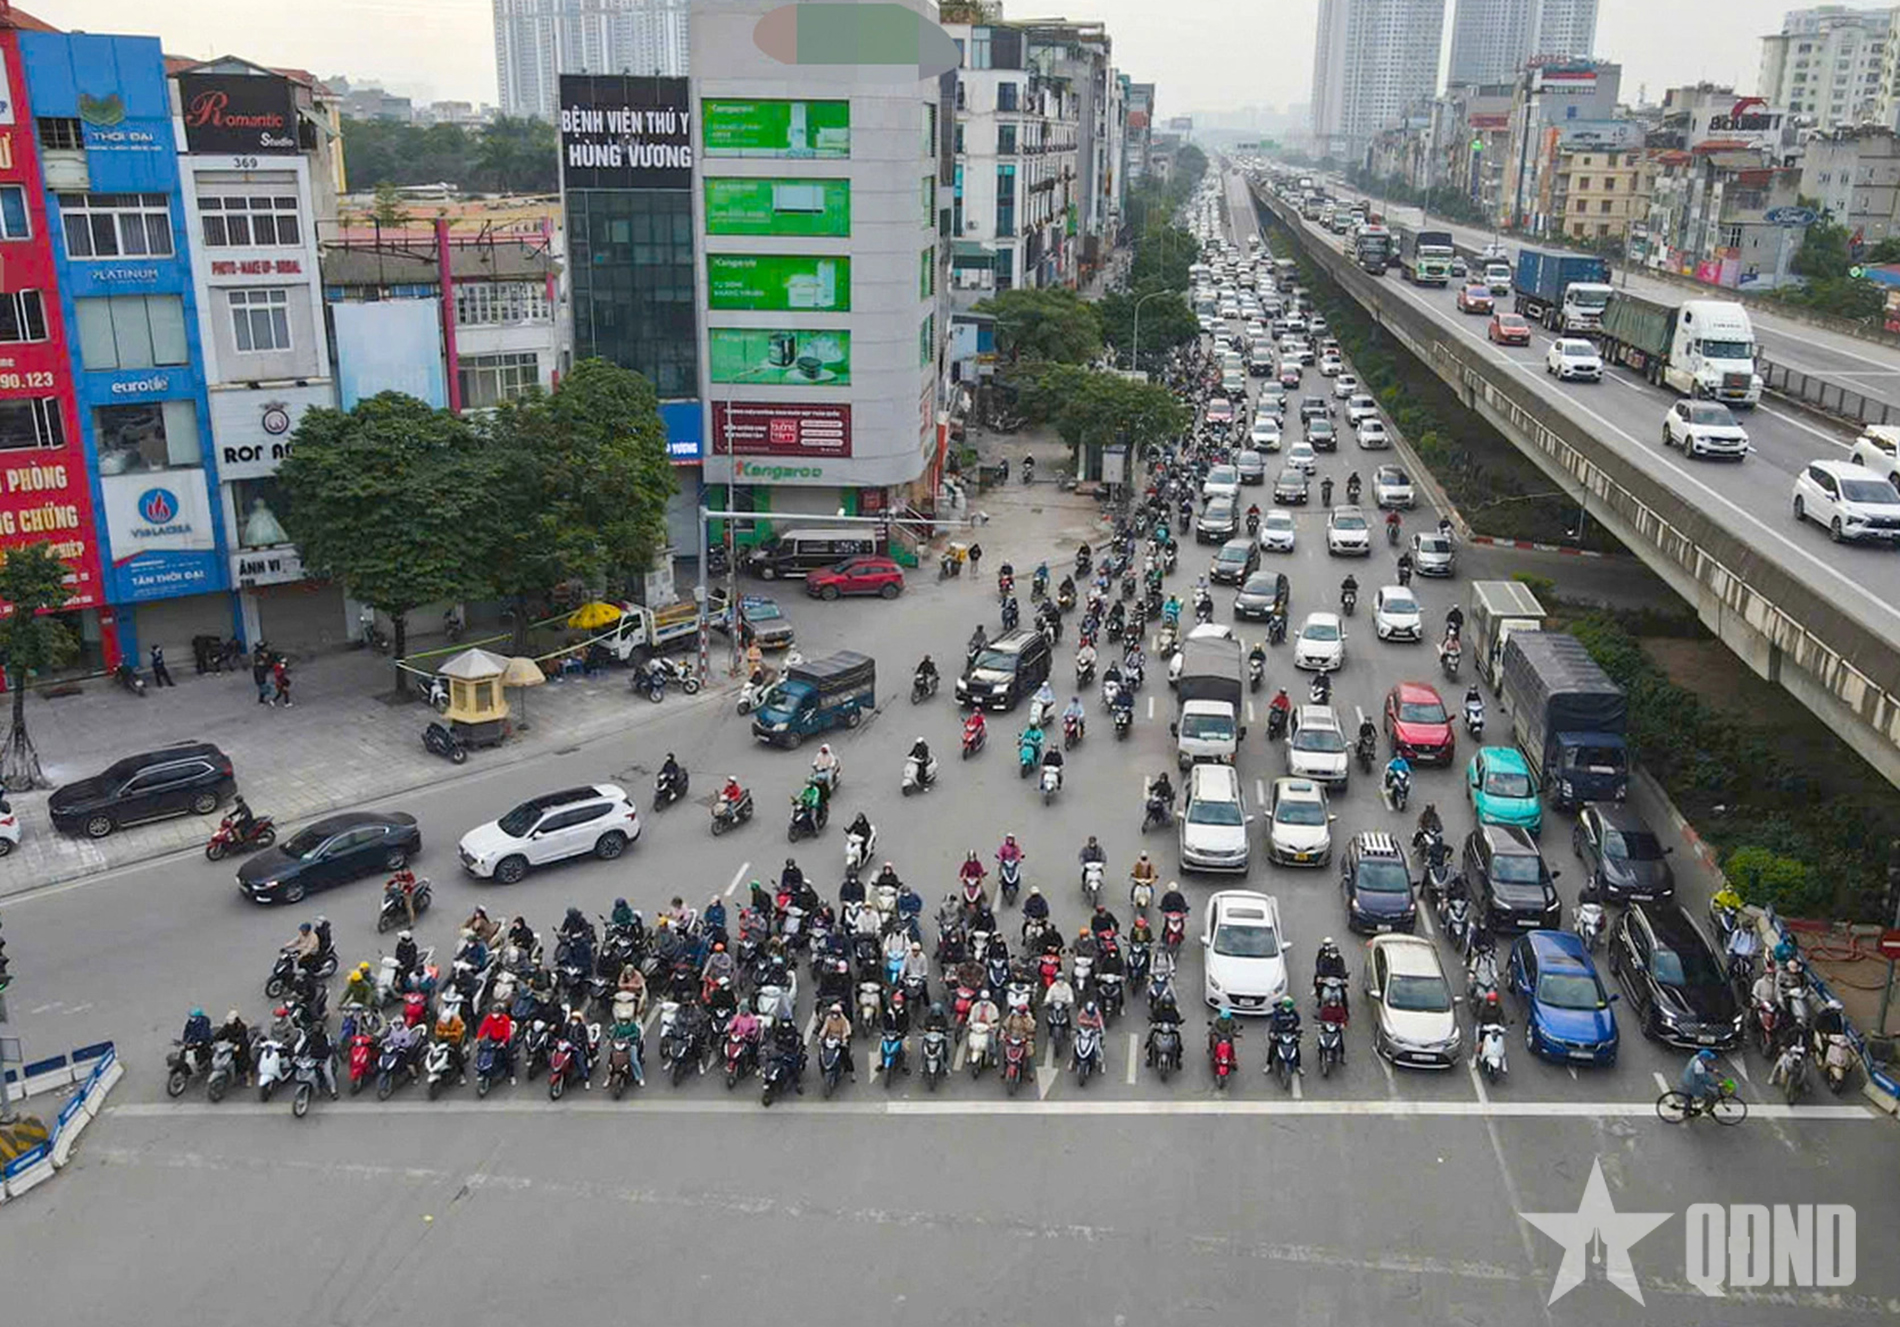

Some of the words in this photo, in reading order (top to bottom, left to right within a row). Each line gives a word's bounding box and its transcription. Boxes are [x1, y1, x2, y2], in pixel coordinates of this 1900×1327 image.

[185, 90, 284, 127] Romantic
[561, 104, 604, 138] BỆNH
[606, 105, 643, 139] VIỆN
[645, 106, 676, 134] THÚ
[679, 112, 690, 135] Y
[260, 132, 294, 147] Studio
[569, 139, 622, 167] HÙNG
[627, 143, 692, 168] VƯƠNG
[233, 157, 258, 168] 369
[6, 461, 67, 493] PHÒNG
[735, 459, 823, 480] Kangaroo
[19, 501, 79, 533] CHỨNG
